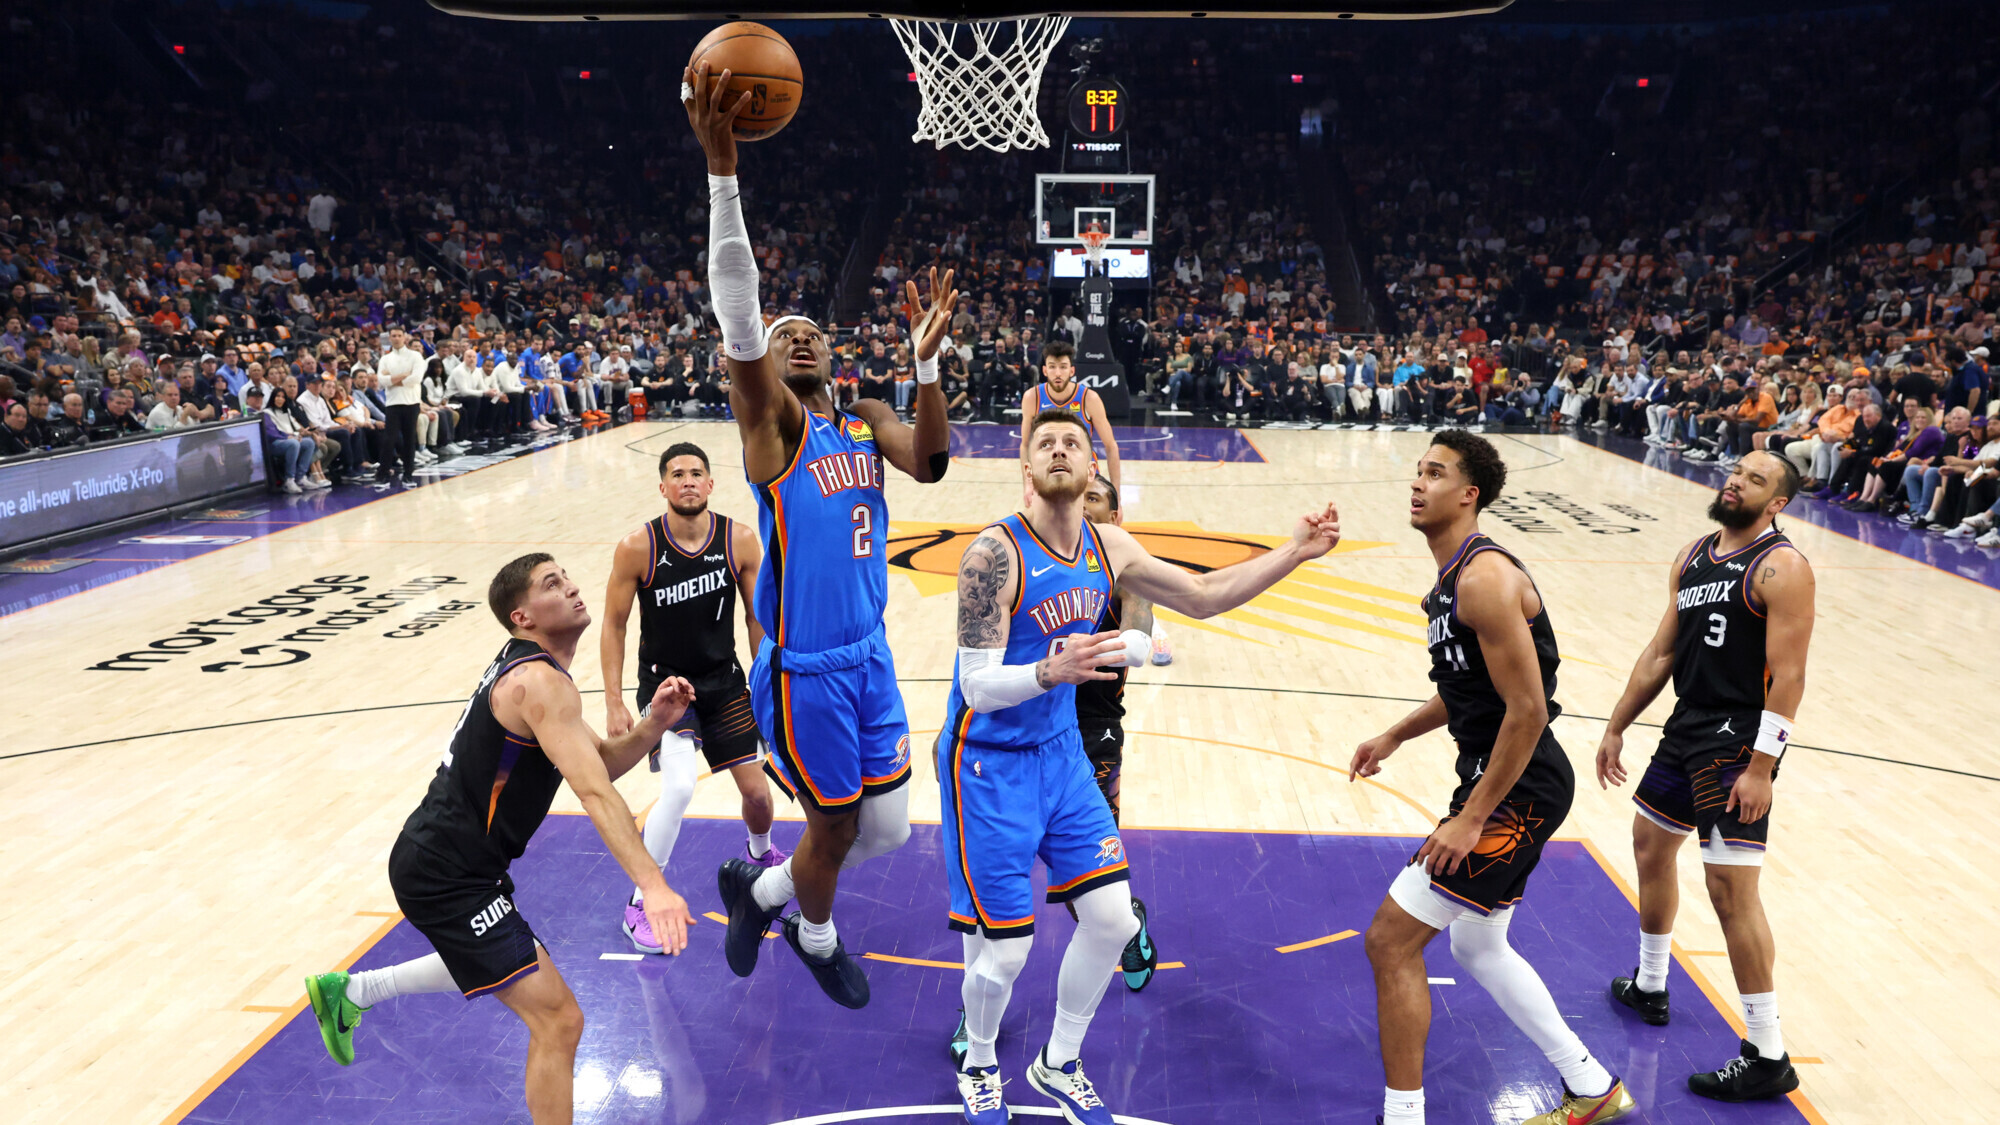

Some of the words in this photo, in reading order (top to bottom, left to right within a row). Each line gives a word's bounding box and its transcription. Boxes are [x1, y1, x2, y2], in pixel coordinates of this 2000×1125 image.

[1086, 90, 1117, 105] 8:32
[1091, 105, 1114, 132] 11
[1090, 293, 1102, 303] GET
[1090, 303, 1102, 314] THE
[1085, 352, 1105, 360] Google
[19, 488, 70, 514] all-new
[72, 475, 128, 501] Telluride
[129, 466, 163, 490] X-Pro
[851, 503, 872, 559] 2
[703, 554, 725, 562] PayPal
[1725, 561, 1746, 572] PayPal
[654, 567, 728, 607] PHOENIX
[83, 574, 371, 672] mortgage
[275, 575, 468, 642] matchup
[382, 599, 482, 639] center
[716, 597, 725, 621] 1
[1027, 587, 1107, 637] THUNDER
[1704, 612, 1728, 648] 3
[1444, 644, 1470, 671] 11
[470, 894, 513, 937] SUNS
